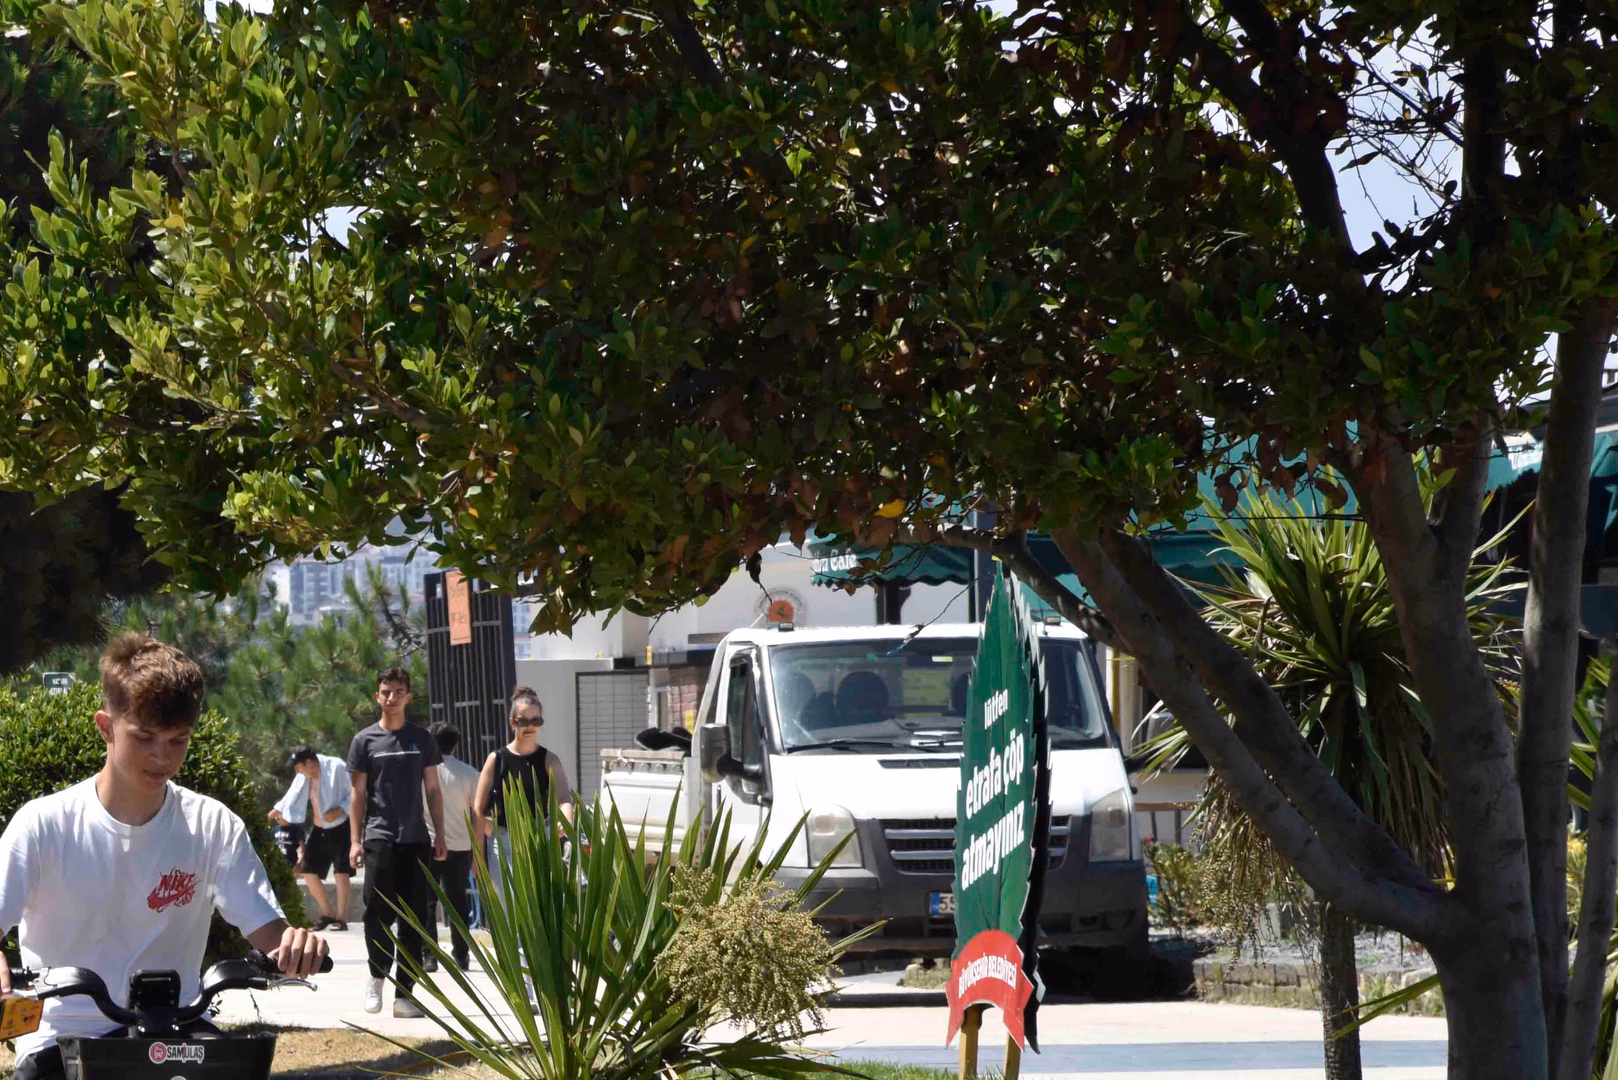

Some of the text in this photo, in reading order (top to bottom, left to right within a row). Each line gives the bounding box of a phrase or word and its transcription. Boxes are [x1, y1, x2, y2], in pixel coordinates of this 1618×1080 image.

[984, 688, 1009, 730] lütfen
[965, 728, 1025, 819] etrafa çöp
[961, 800, 1025, 891] atmayınız
